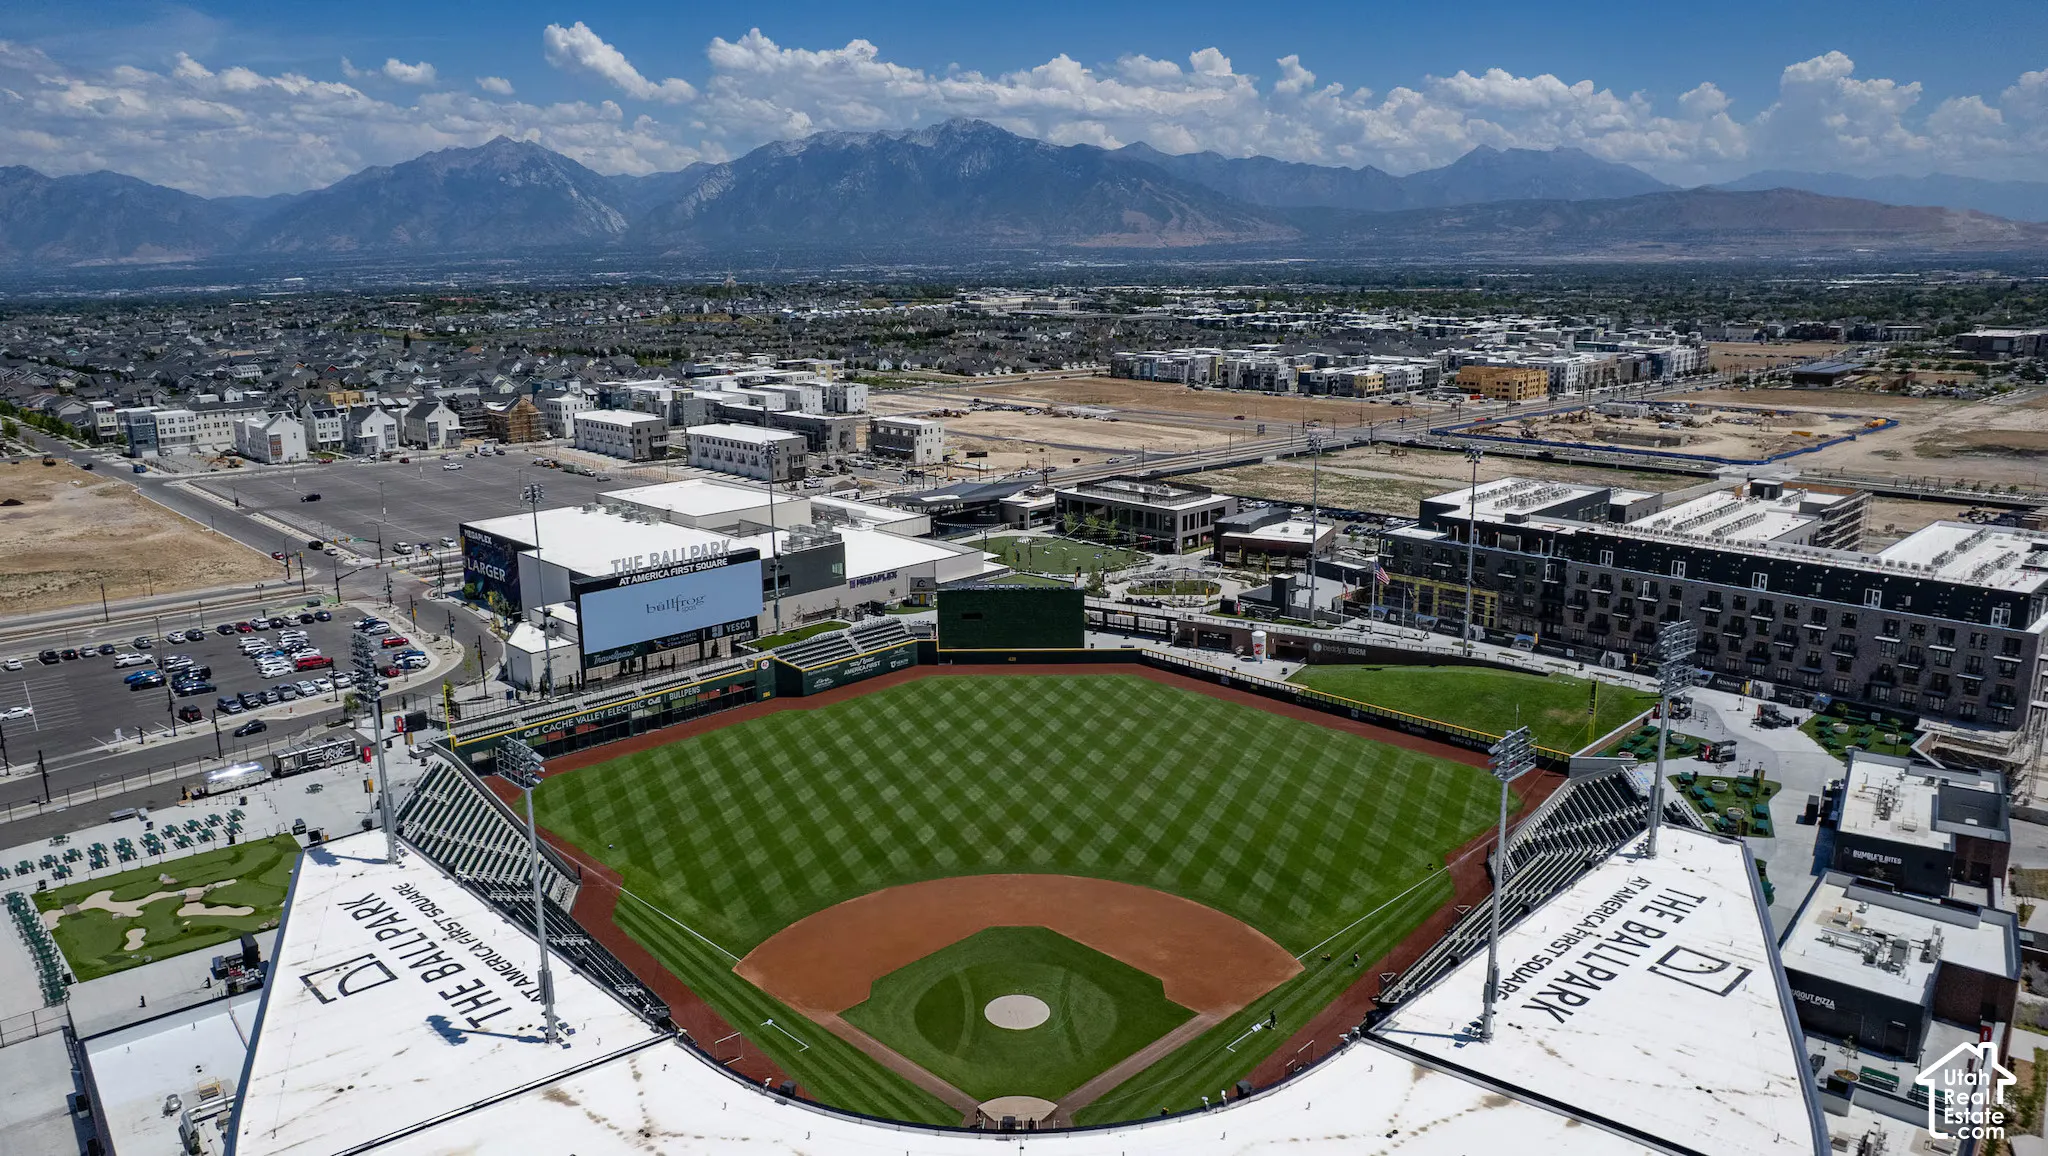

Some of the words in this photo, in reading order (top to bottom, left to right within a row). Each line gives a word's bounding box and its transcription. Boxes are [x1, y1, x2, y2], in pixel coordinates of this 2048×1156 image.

[464, 529, 493, 545] MEGAPLEX
[467, 557, 506, 582] LARGER
[611, 555, 643, 577] THE
[650, 539, 732, 570] BALLPARK
[619, 578, 631, 586] AT
[631, 568, 670, 584] AMERICA
[670, 564, 695, 577] FIRST
[696, 558, 728, 570] SQUARE
[726, 620, 751, 633] YESCO
[1347, 647, 1366, 656] BERM
[669, 686, 700, 700] BULLPENS
[542, 719, 574, 734] CACHE
[575, 709, 606, 725] VALLEY
[607, 700, 645, 717] ELECTRIC
[1629, 875, 1653, 891] AT
[392, 882, 444, 918] SQUARE
[1577, 886, 1639, 930] AMERICA
[1639, 888, 1708, 924] THE
[337, 892, 466, 983] BALLPARK
[433, 918, 475, 946] FIRST
[1544, 926, 1591, 958] FIRST
[469, 941, 535, 987] AMERICA
[1521, 919, 1668, 1024] BALLPARK
[438, 978, 513, 1029] THE
[1815, 995, 1835, 1010] PIZZA
